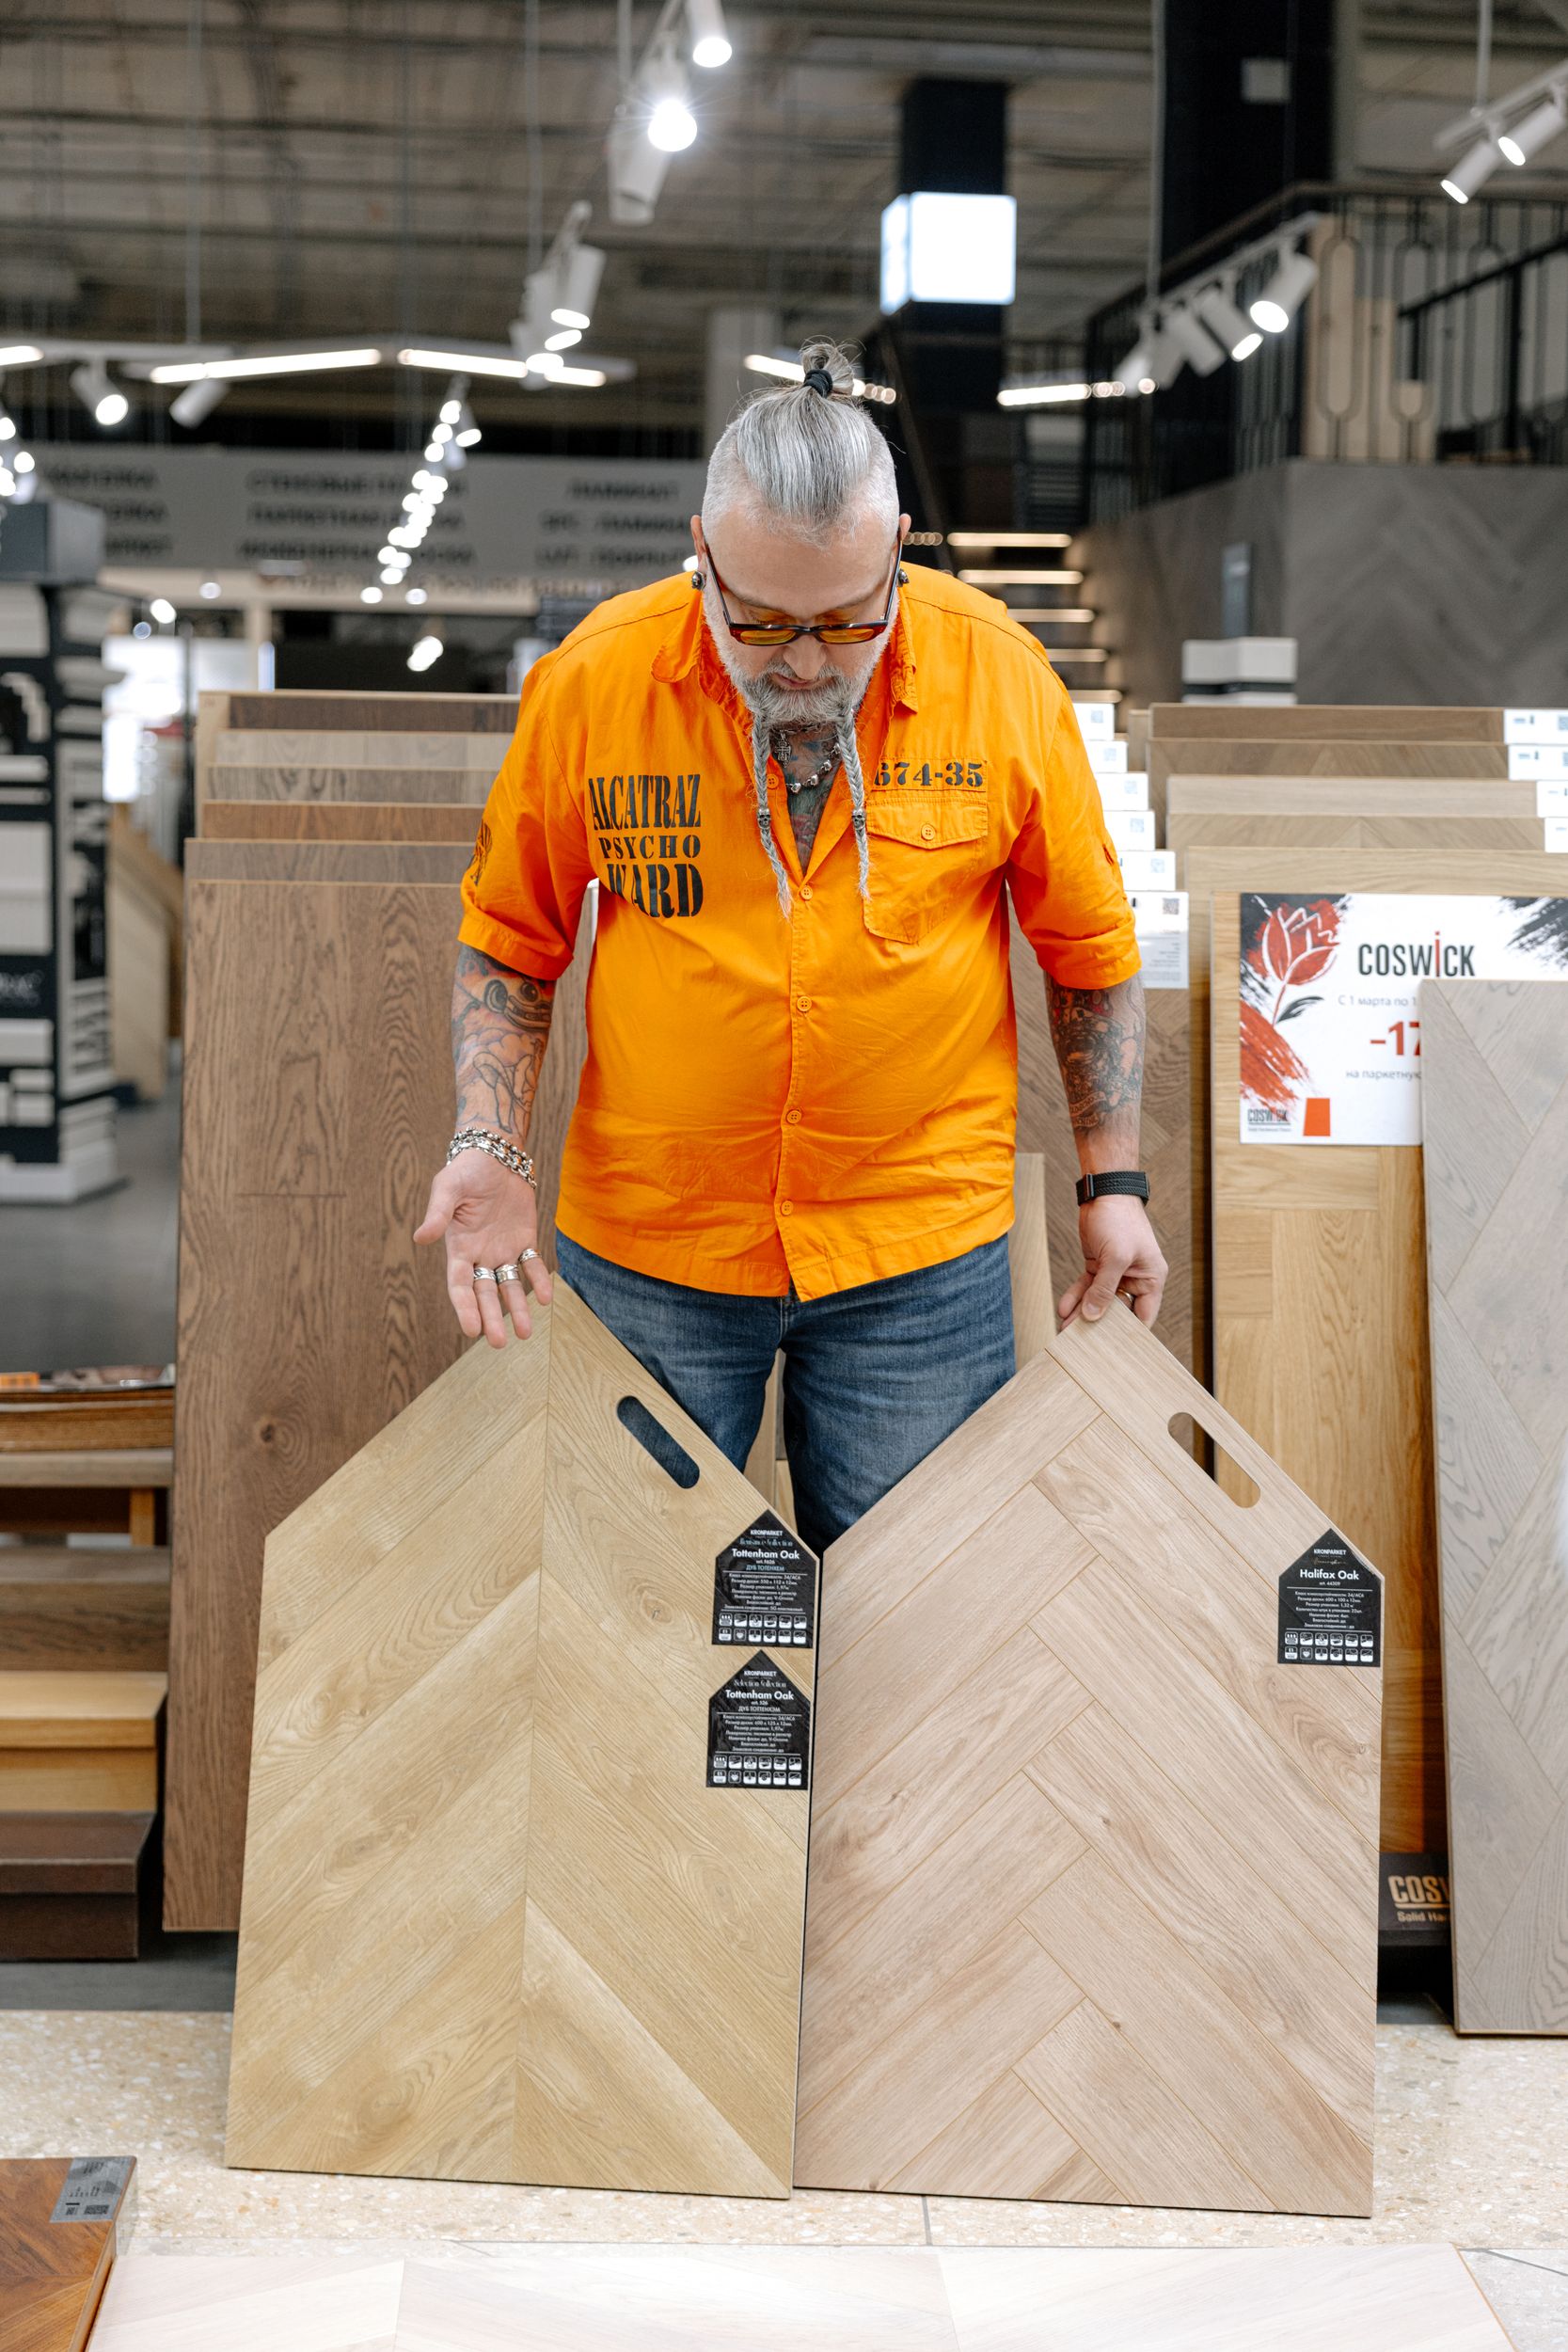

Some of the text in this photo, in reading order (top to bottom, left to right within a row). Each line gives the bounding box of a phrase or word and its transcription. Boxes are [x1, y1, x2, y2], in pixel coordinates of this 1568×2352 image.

[874, 761, 983, 787] 674-35
[588, 774, 701, 830] ALCATRAZ
[598, 834, 701, 859] PSYCHO
[607, 864, 704, 918] WARD
[1350, 995, 1355, 1006] 1
[1358, 997, 1392, 1008] марта
[1394, 997, 1410, 1007] по
[1345, 1071, 1360, 1079] на
[732, 1549, 800, 1561] Tottenham Oak
[1299, 1568, 1359, 1581] Halifax Oak
[725, 1690, 795, 1701] Tottenham Oak
